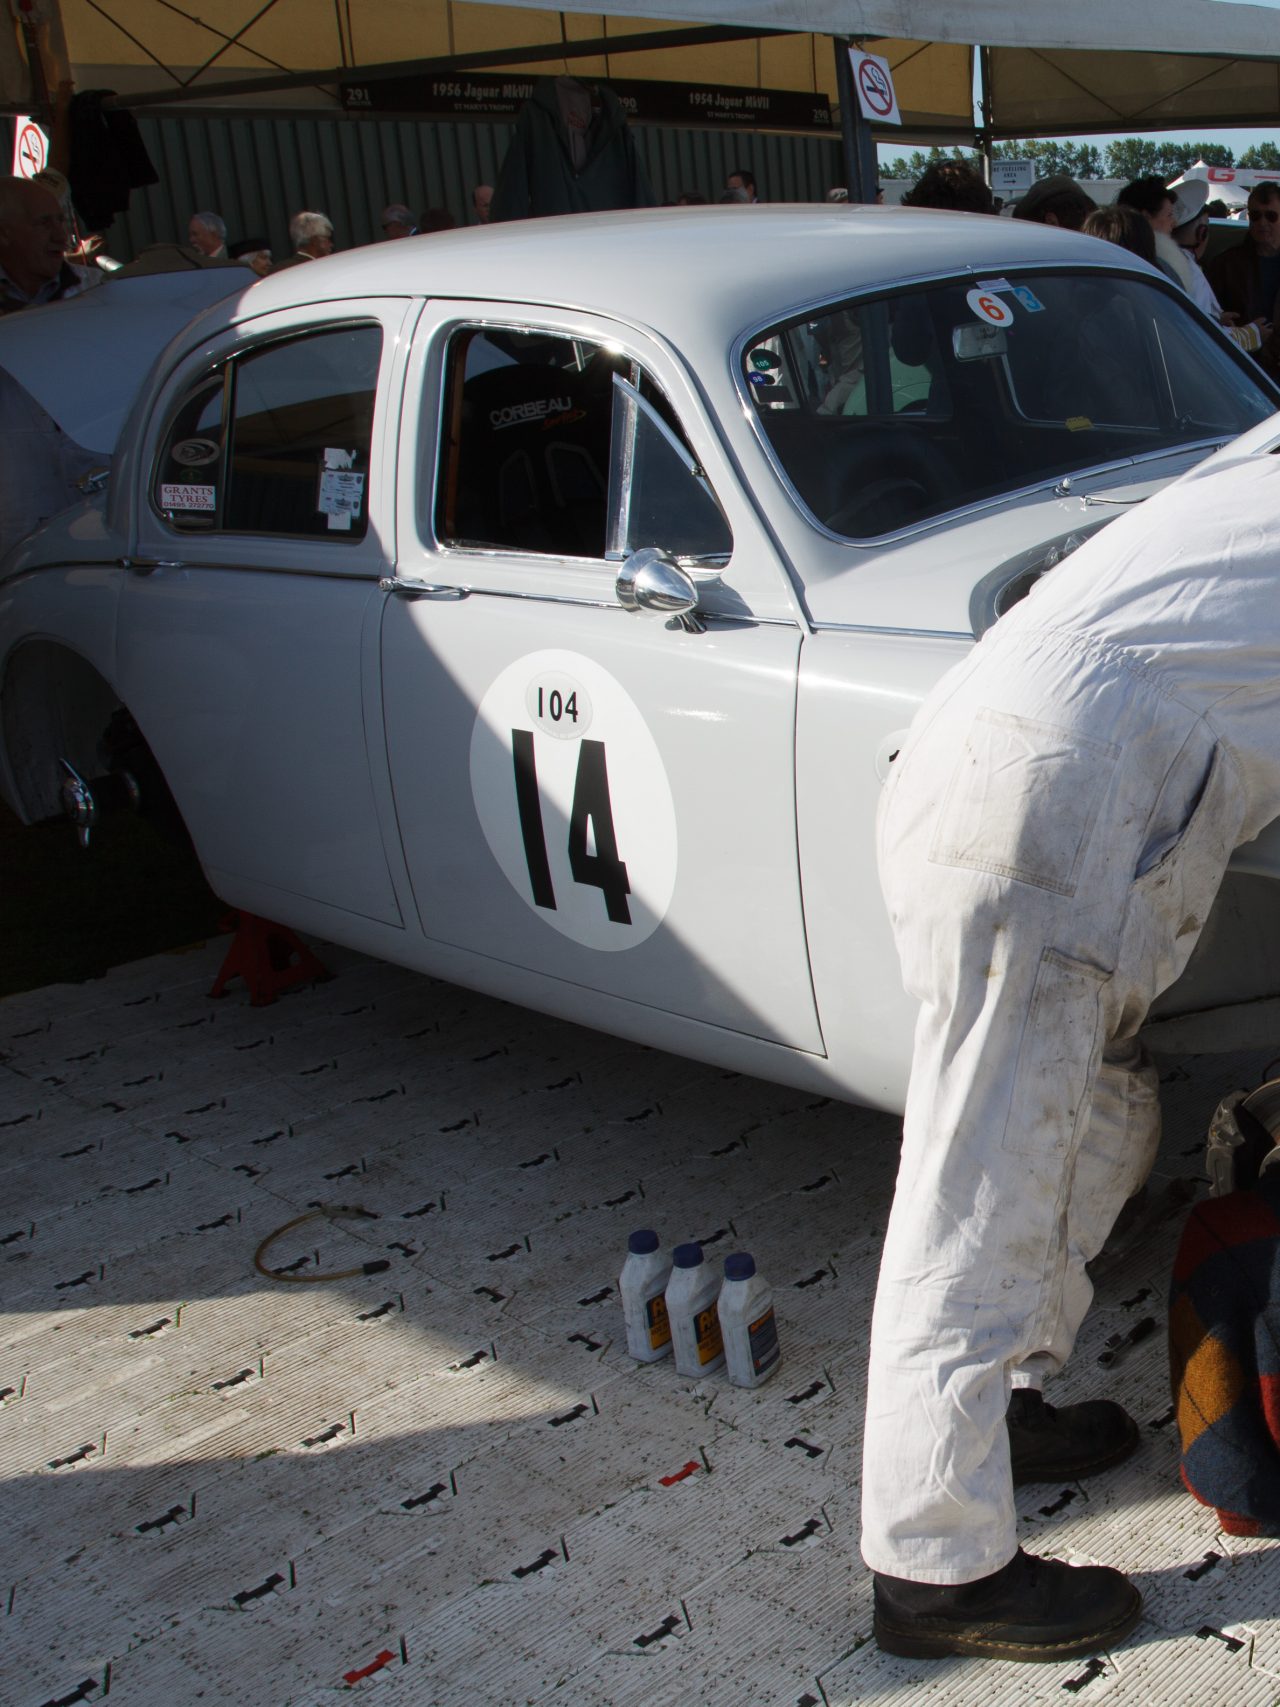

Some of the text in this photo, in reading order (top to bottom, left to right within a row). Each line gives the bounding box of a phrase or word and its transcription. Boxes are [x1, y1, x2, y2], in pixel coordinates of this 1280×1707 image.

[346, 87, 369, 100] 291
[432, 82, 461, 97] 1956
[464, 82, 500, 101] Jaguar
[689, 91, 713, 106] 1954
[714, 92, 743, 110] Jaguar
[979, 296, 1005, 320] 6
[1014, 287, 1040, 309] 3
[489, 396, 573, 426] CORBEAU
[164, 486, 214, 496] GRANTS
[170, 495, 208, 503] TYRES
[538, 686, 579, 722] 104
[511, 728, 632, 925] 14
